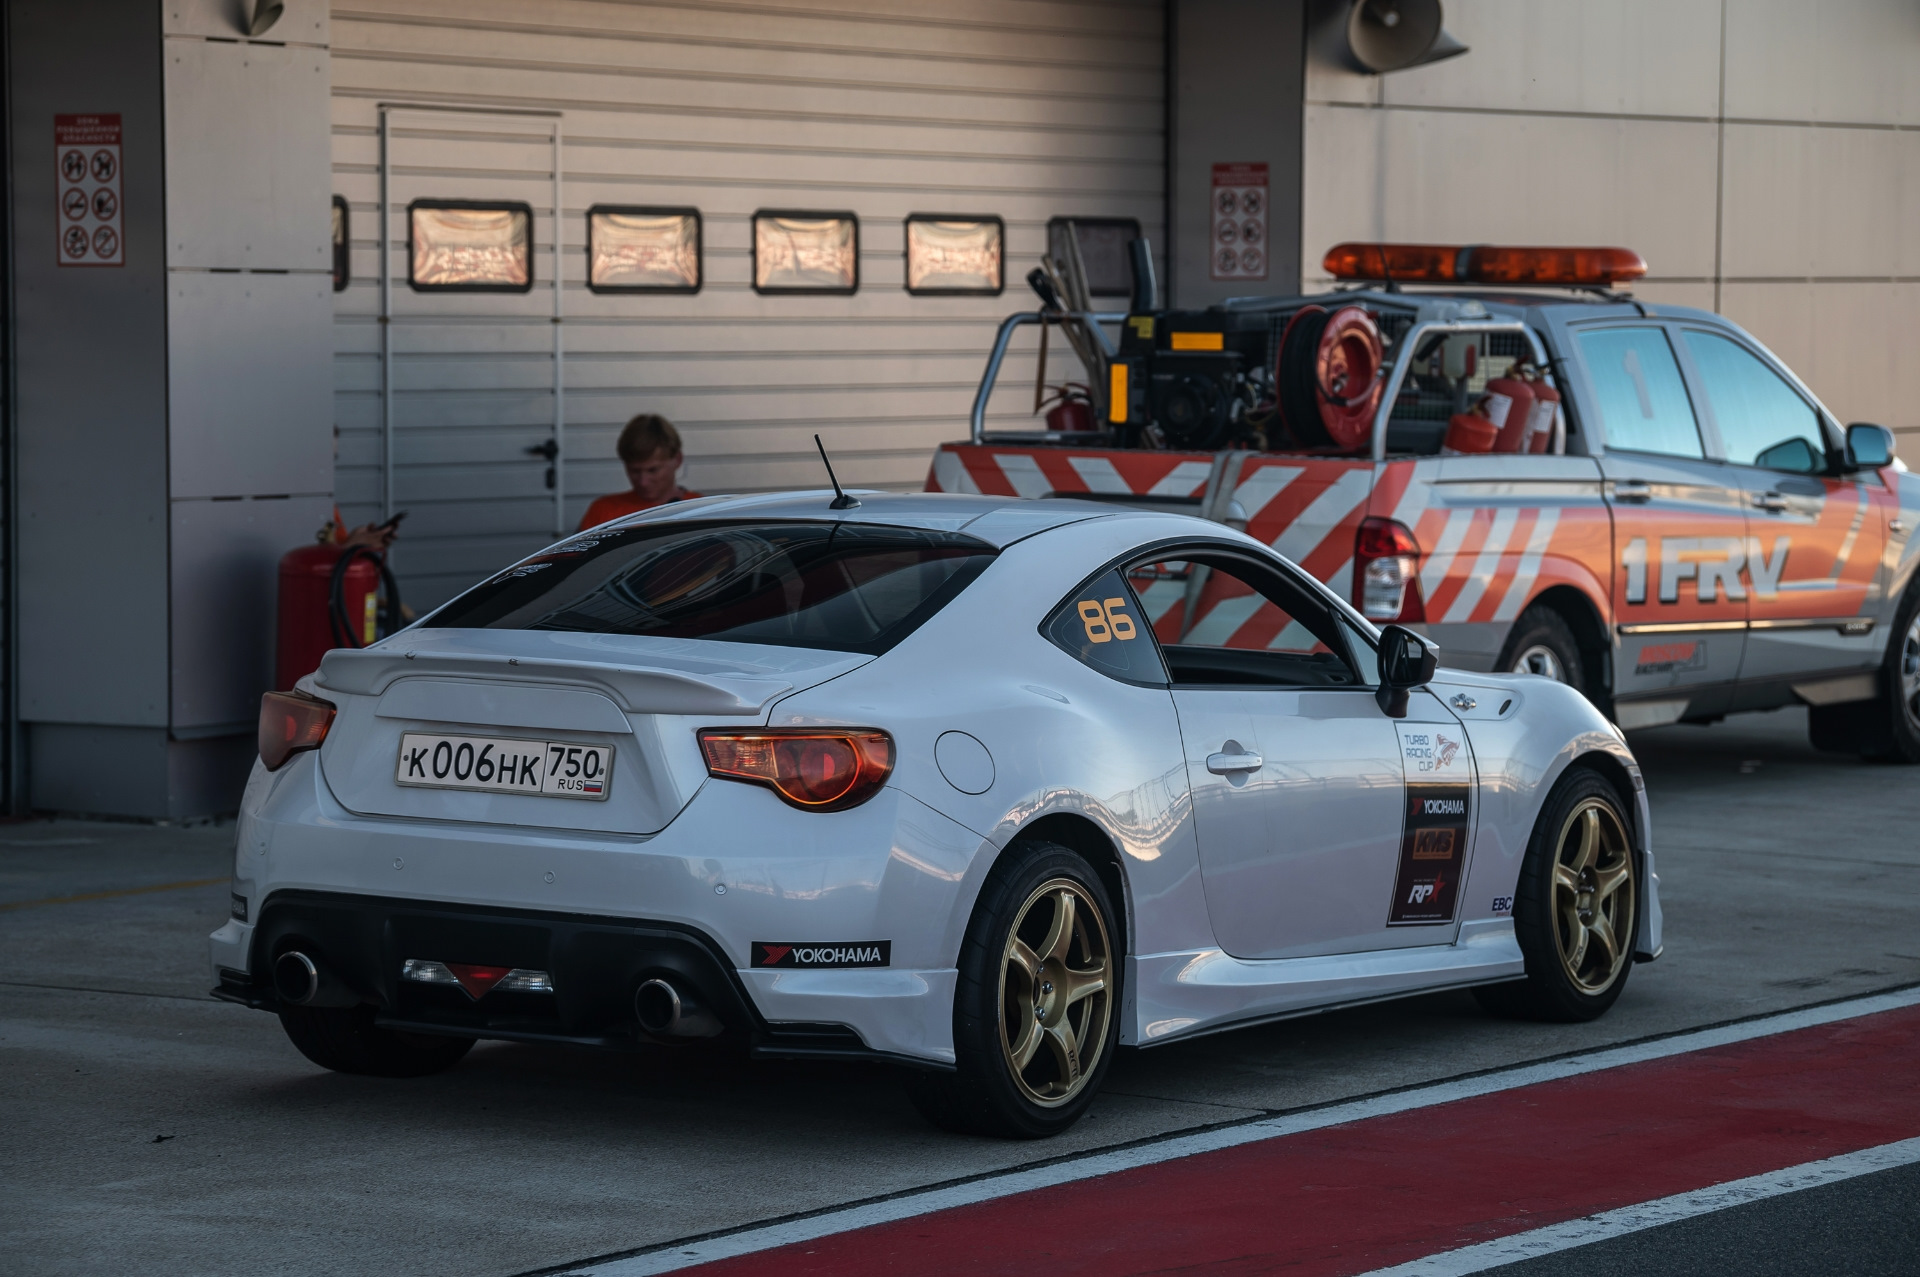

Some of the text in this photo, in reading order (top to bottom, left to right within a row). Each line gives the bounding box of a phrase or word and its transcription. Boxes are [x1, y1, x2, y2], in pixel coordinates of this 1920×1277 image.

[1077, 597, 1137, 644] 86
[1404, 735, 1430, 745] TURBO
[1405, 747, 1432, 758] RACING
[549, 747, 600, 779] 750
[1418, 761, 1434, 772] CUP
[557, 778, 584, 791] RUS
[1423, 799, 1465, 814] YOKOHAMA
[1416, 831, 1453, 853] KMS
[1491, 896, 1512, 911] EBC
[791, 946, 882, 963] YOKOHAMA
